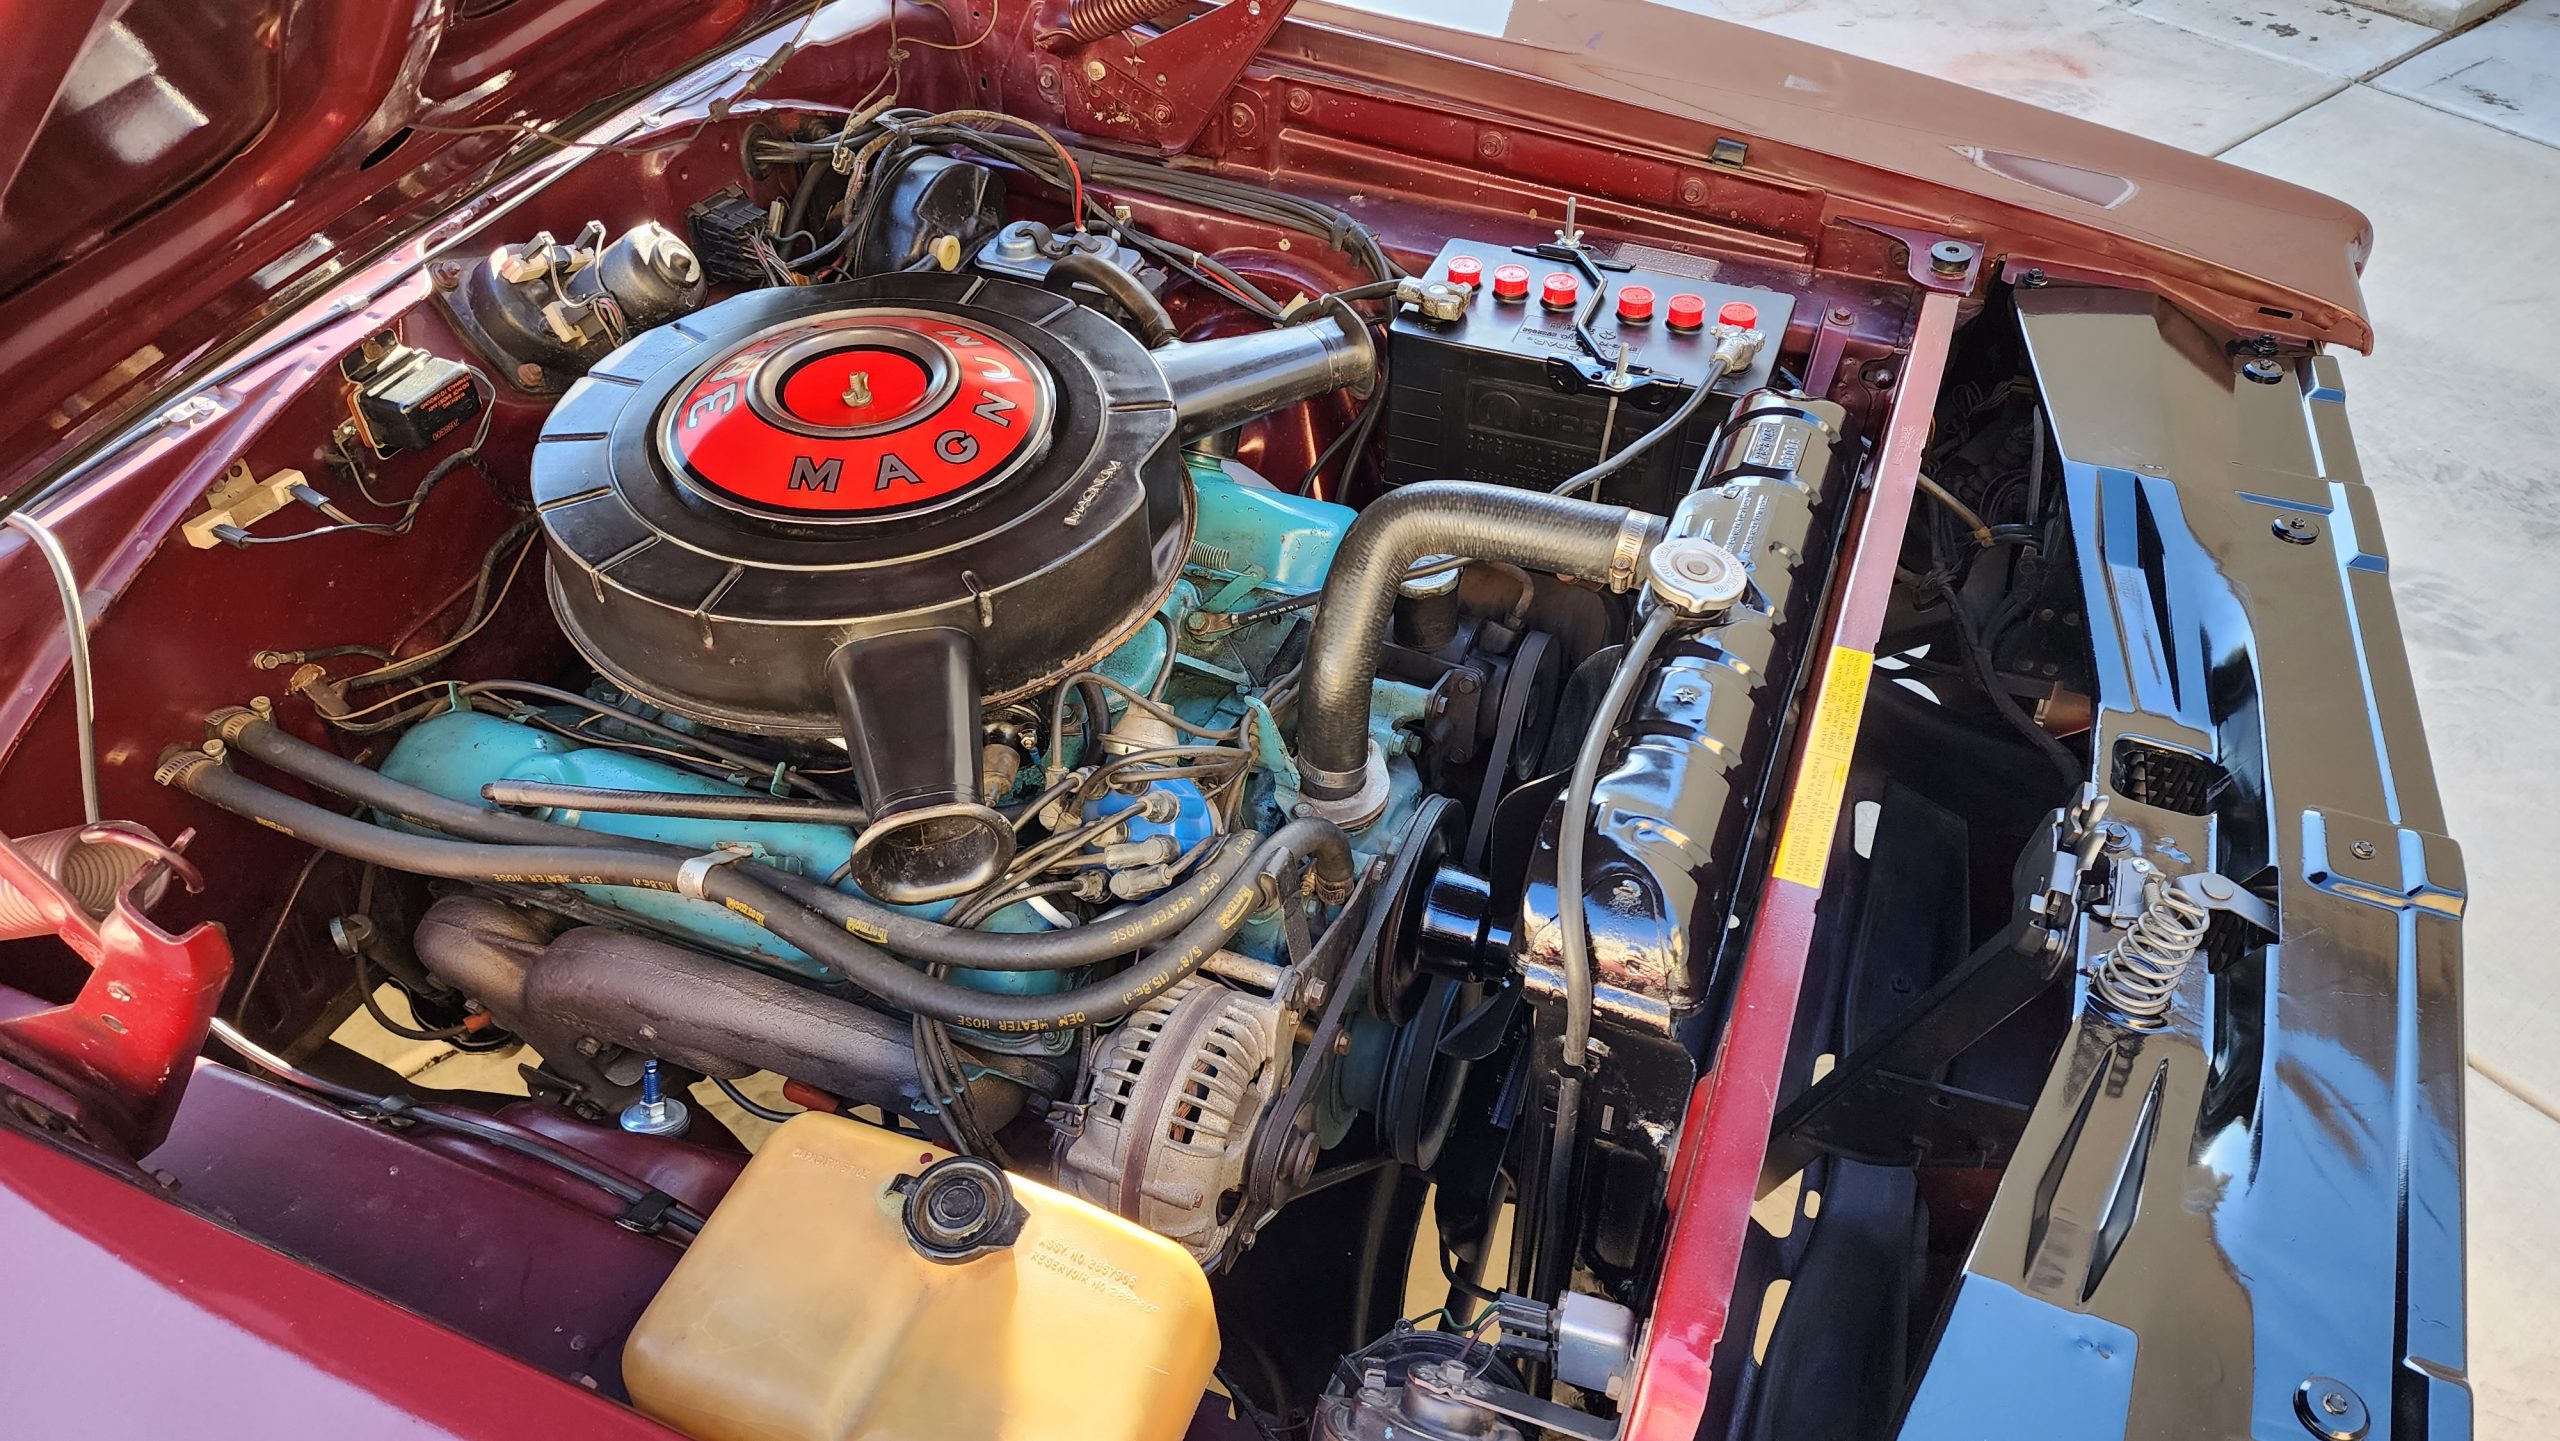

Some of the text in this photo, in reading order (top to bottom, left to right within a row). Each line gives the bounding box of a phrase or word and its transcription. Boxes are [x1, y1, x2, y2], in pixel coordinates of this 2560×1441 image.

[788, 329, 1018, 492] MAGNUM
[1062, 460, 1121, 524] MAGNUM
[491, 873, 523, 881] HOSE
[1148, 893, 1196, 927] HEATER
[1111, 923, 1145, 944] HOSE
[957, 1015, 989, 1028] HOSE
[997, 1017, 1048, 1032] HEATER
[1031, 1251, 1089, 1285] RESERVOIR
